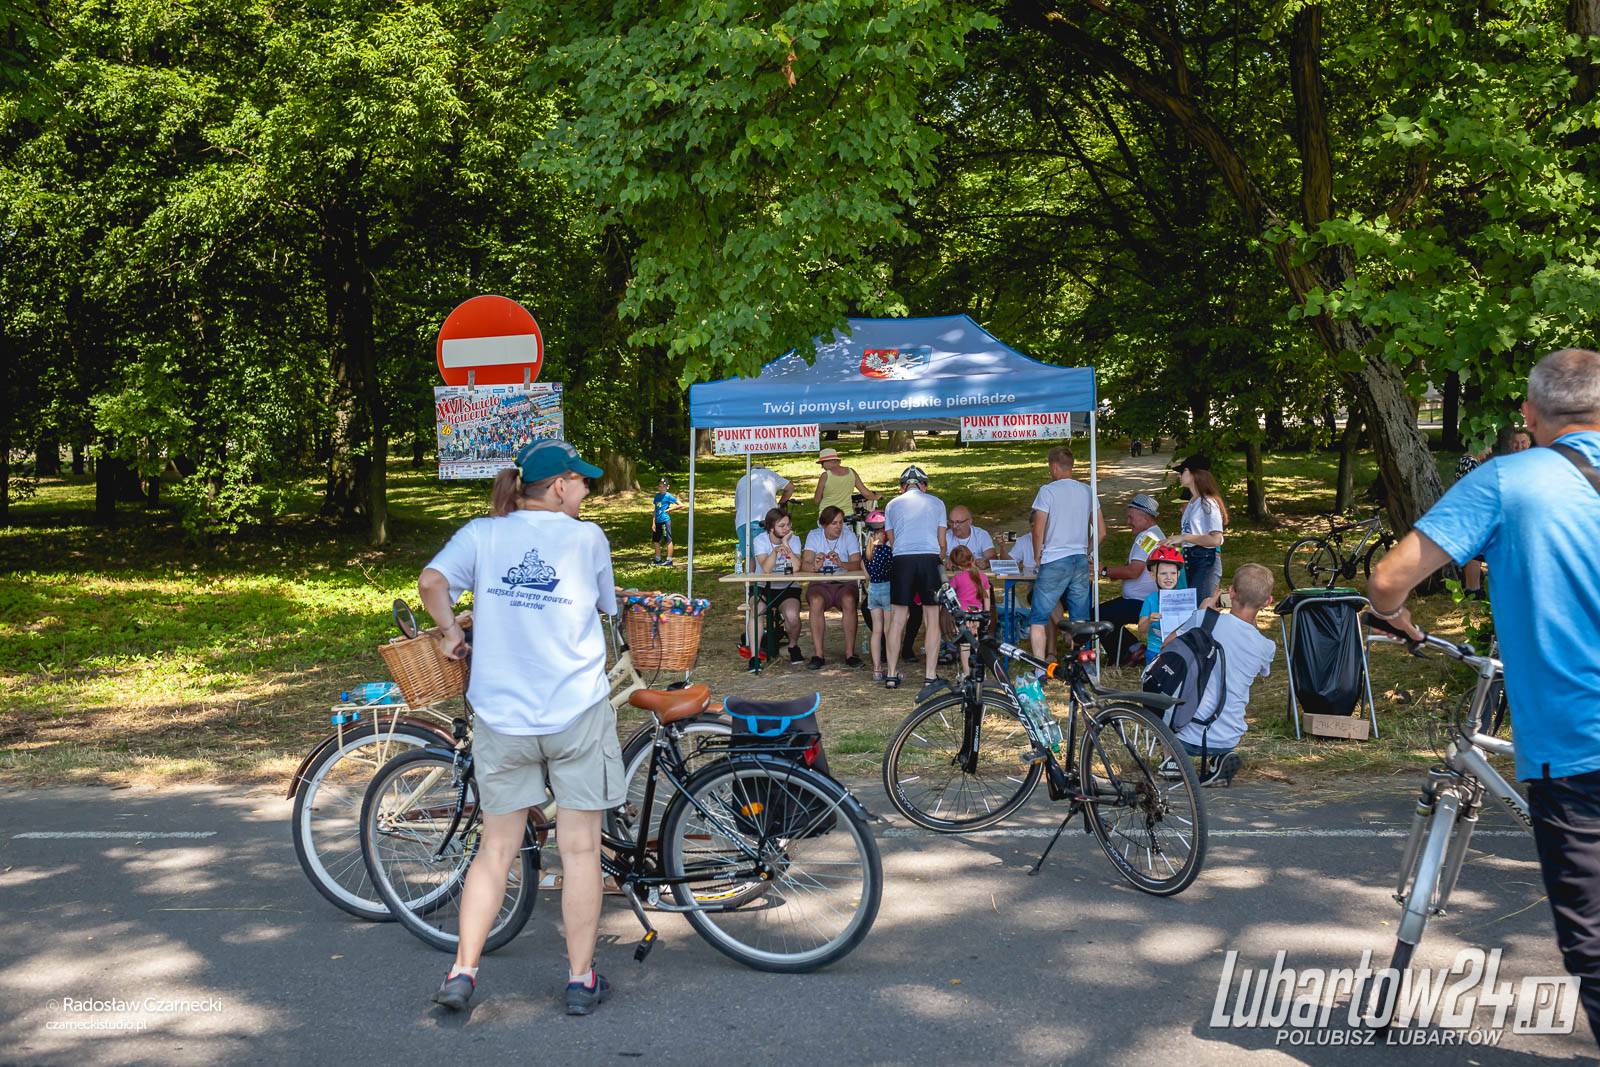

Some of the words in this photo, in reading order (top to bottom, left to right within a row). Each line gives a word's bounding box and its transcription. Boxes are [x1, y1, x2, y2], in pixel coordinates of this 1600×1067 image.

[763, 402, 795, 415] Twój
[800, 400, 854, 415] pomysł,
[858, 396, 942, 411] europejskie
[947, 393, 1016, 408] pieniądze
[963, 415, 1000, 427] PUNKT
[1003, 412, 1069, 426] KONTROLNY
[717, 428, 752, 441] PUNKT
[755, 425, 817, 439] KONTROLNY
[992, 429, 1037, 439] KOZŁÓWKA
[744, 442, 788, 451] KOZŁÓWKA
[487, 587, 515, 598] MIEJSKIE
[542, 595, 574, 605] ROWERU
